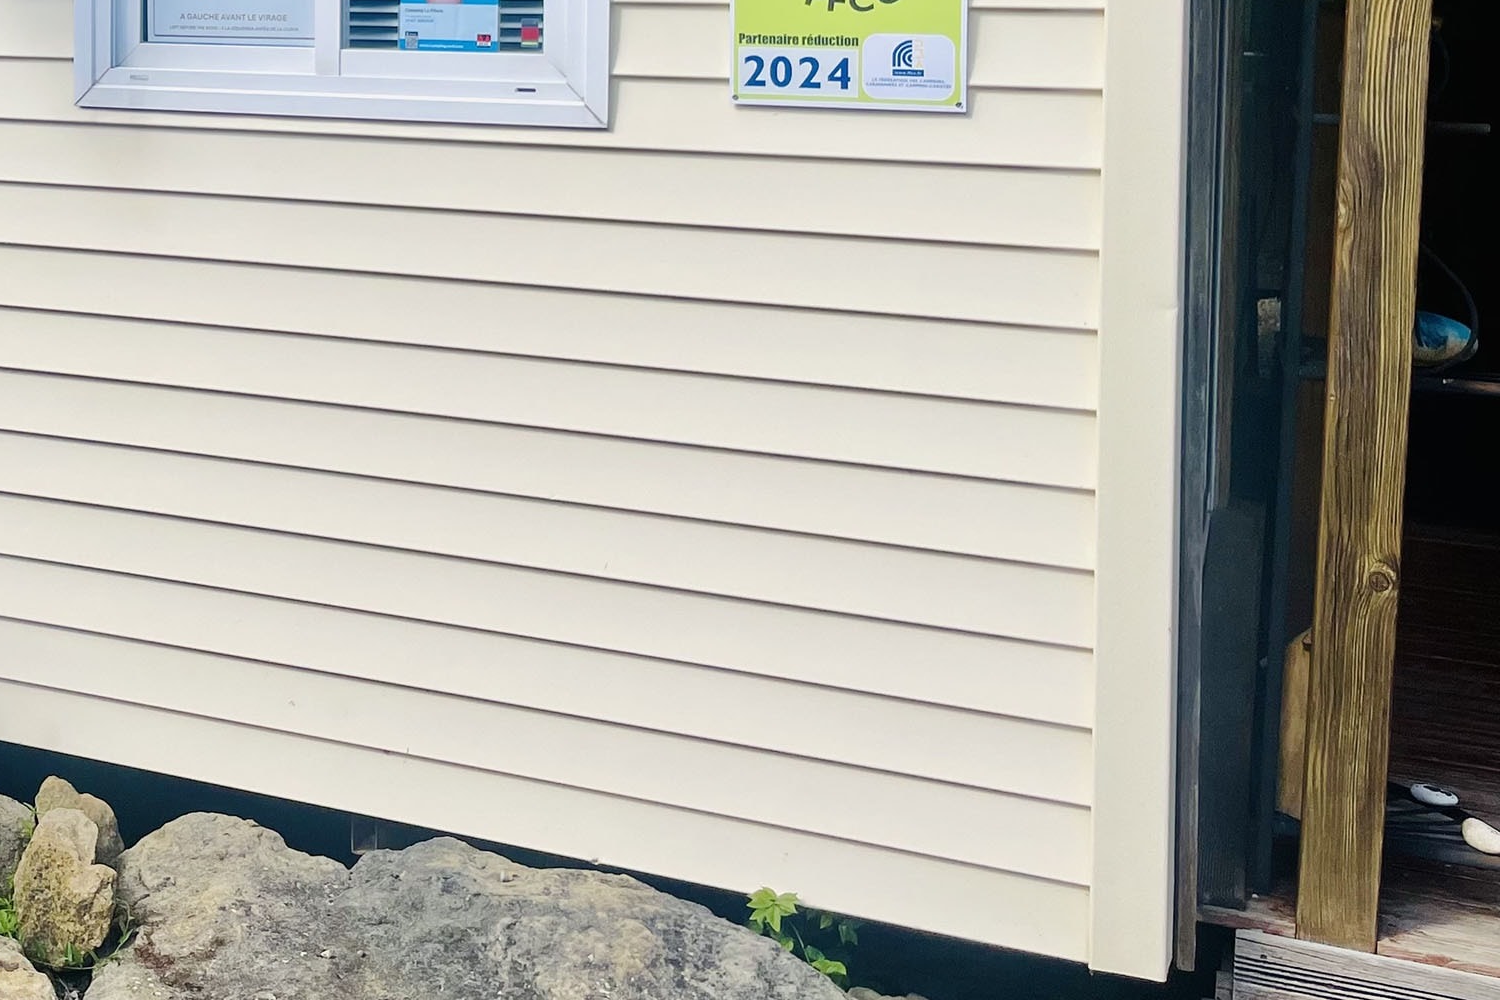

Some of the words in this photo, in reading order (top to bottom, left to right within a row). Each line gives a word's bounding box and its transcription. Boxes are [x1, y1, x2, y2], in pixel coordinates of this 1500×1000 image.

[187, 13, 219, 21] GAUCHE
[221, 13, 247, 21] AVANT
[739, 33, 799, 46] Partenaire
[802, 33, 859, 47] réduction
[744, 56, 851, 90] 2024
